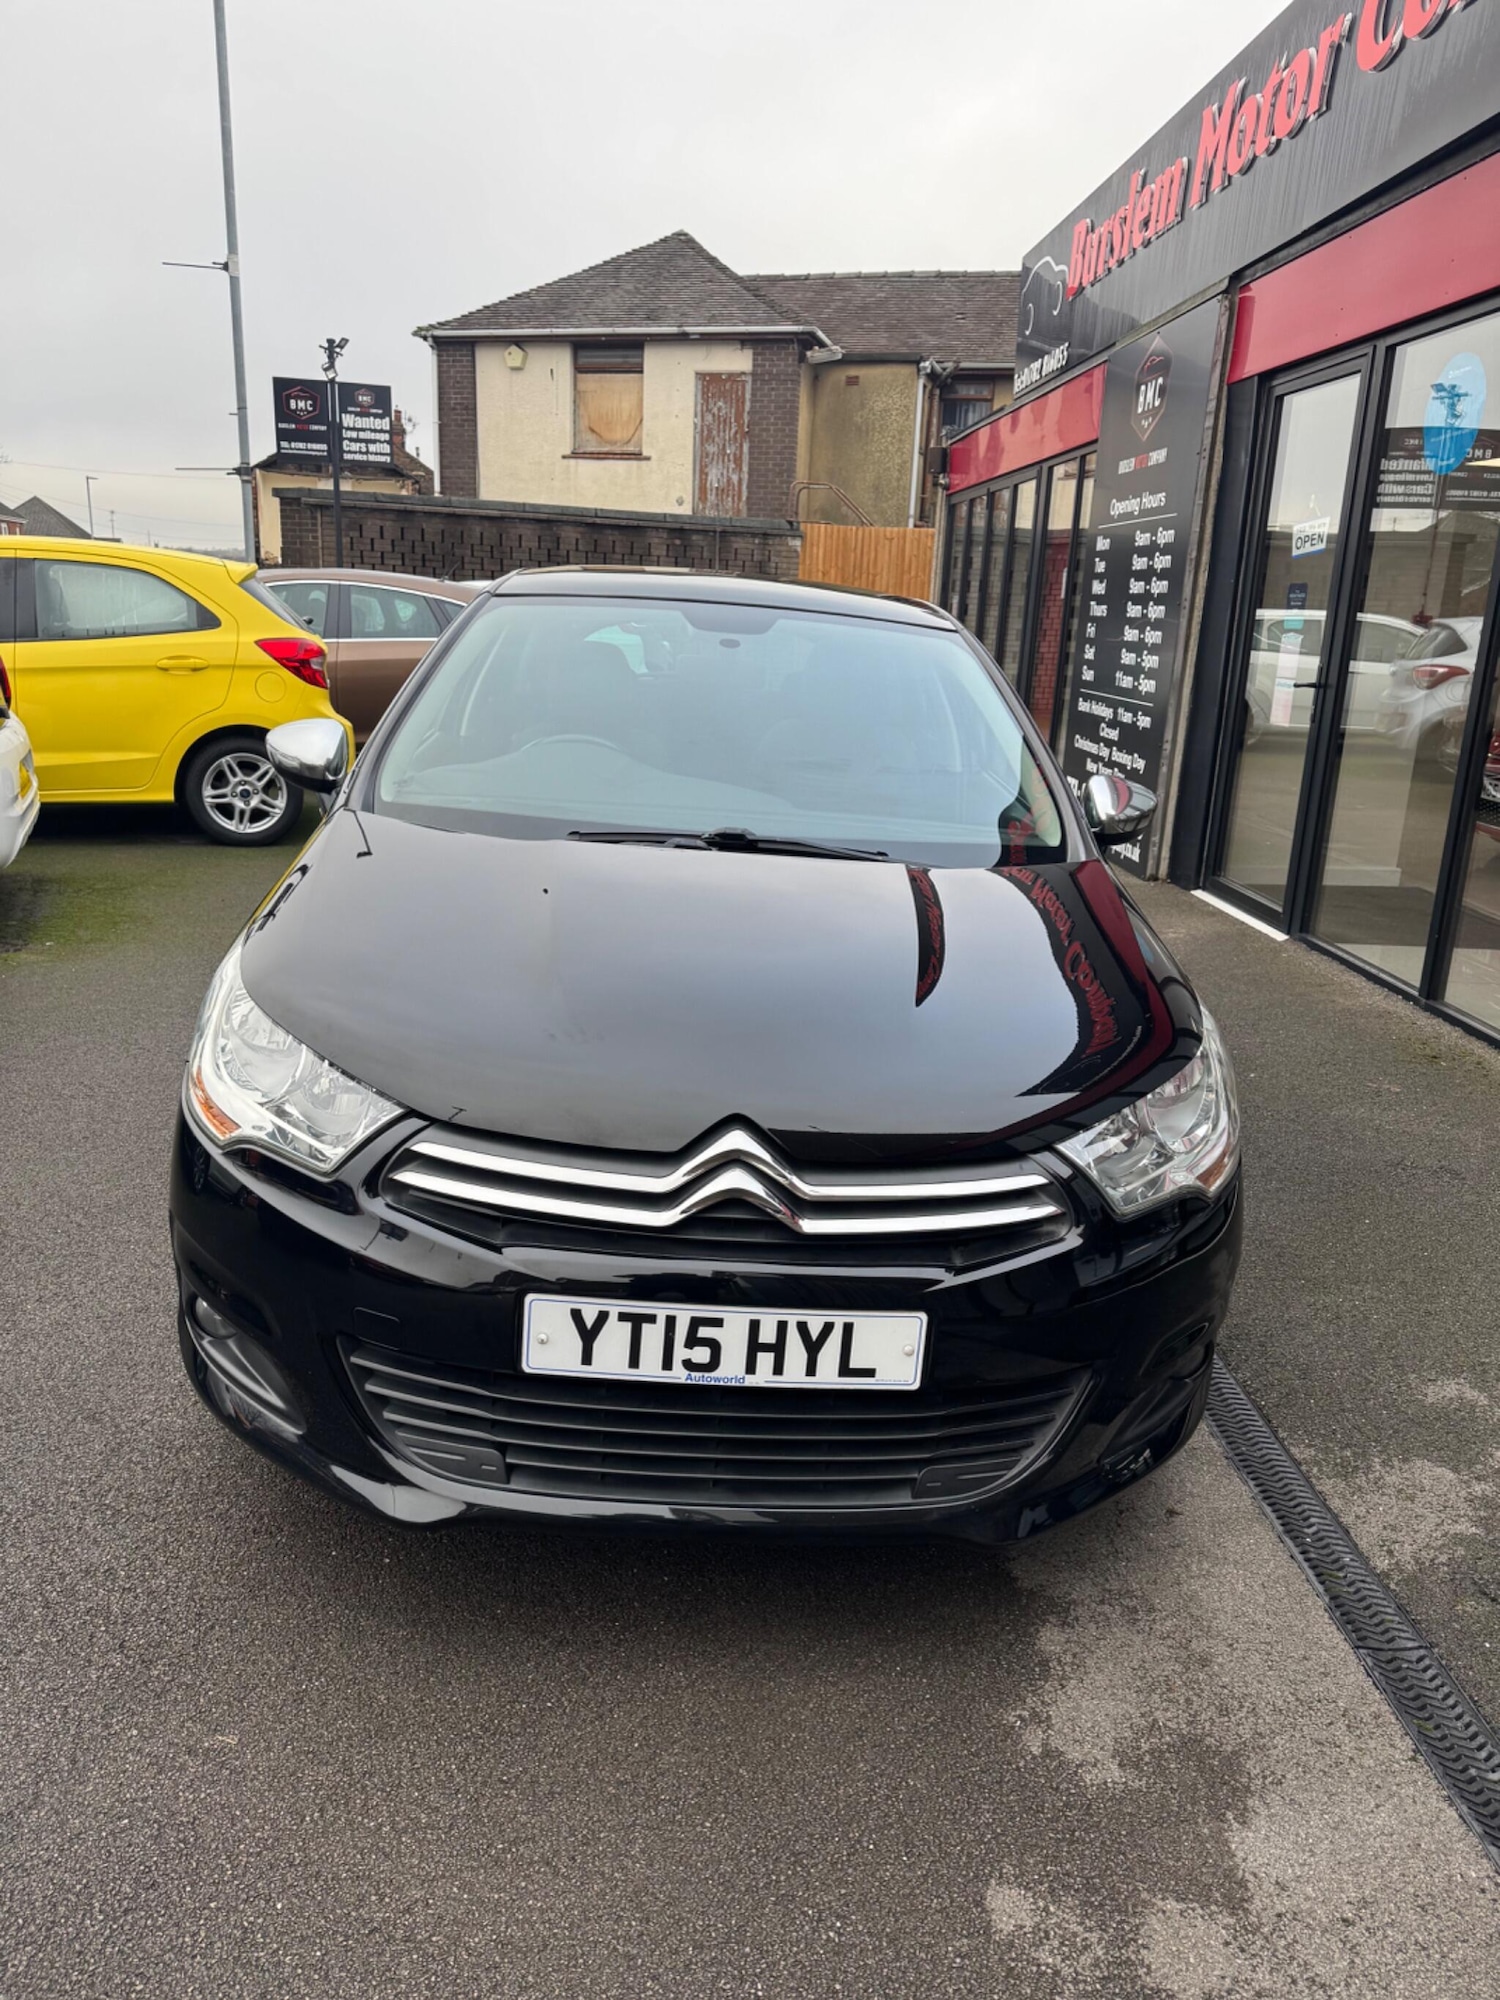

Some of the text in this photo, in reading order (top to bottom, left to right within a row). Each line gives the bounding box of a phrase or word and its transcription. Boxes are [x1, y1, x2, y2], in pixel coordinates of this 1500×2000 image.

[1066, 157, 1189, 301] Burslem
[1189, 12, 1352, 210] Motor
[289, 398, 313, 411] BMC
[1137, 376, 1164, 414] BMC
[341, 413, 390, 431] Wanted
[342, 429, 390, 441] Low mileage
[342, 440, 390, 453] Cars with
[1110, 491, 1166, 519] Opening Hours
[1096, 536, 1111, 551] Mon
[1135, 530, 1151, 547] 9am
[1156, 527, 1175, 548] 6pm
[1295, 531, 1325, 550] OPEN
[1095, 557, 1106, 573] Tue
[1132, 554, 1148, 571] 9am
[1153, 552, 1171, 573] 6pm
[1092, 579, 1107, 595] Wed
[1129, 578, 1145, 594] 9am
[1151, 576, 1169, 598] 6pm
[1090, 601, 1108, 617] Thurs
[1126, 601, 1142, 618] 9am
[1148, 601, 1166, 622] 6pm
[1086, 622, 1096, 638] Fri
[1124, 625, 1140, 642] 9am
[1145, 626, 1163, 648] 6pm
[1084, 644, 1096, 660] Sat
[1121, 648, 1137, 666] 9am
[1141, 650, 1159, 671] 5pm
[1082, 665, 1095, 682] Sun
[1115, 670, 1134, 689] 11am
[1138, 674, 1157, 696] 5pm
[1078, 697, 1091, 713] Bank
[1091, 700, 1114, 722] Holidays
[1117, 707, 1133, 724] 11am
[1137, 711, 1152, 730] 5pm
[1099, 722, 1120, 741] Closed
[1074, 734, 1147, 774] Christmas Day Boxing Day
[570, 1308, 877, 1379] YT15 HYL
[685, 1373, 746, 1385] Autoworld
